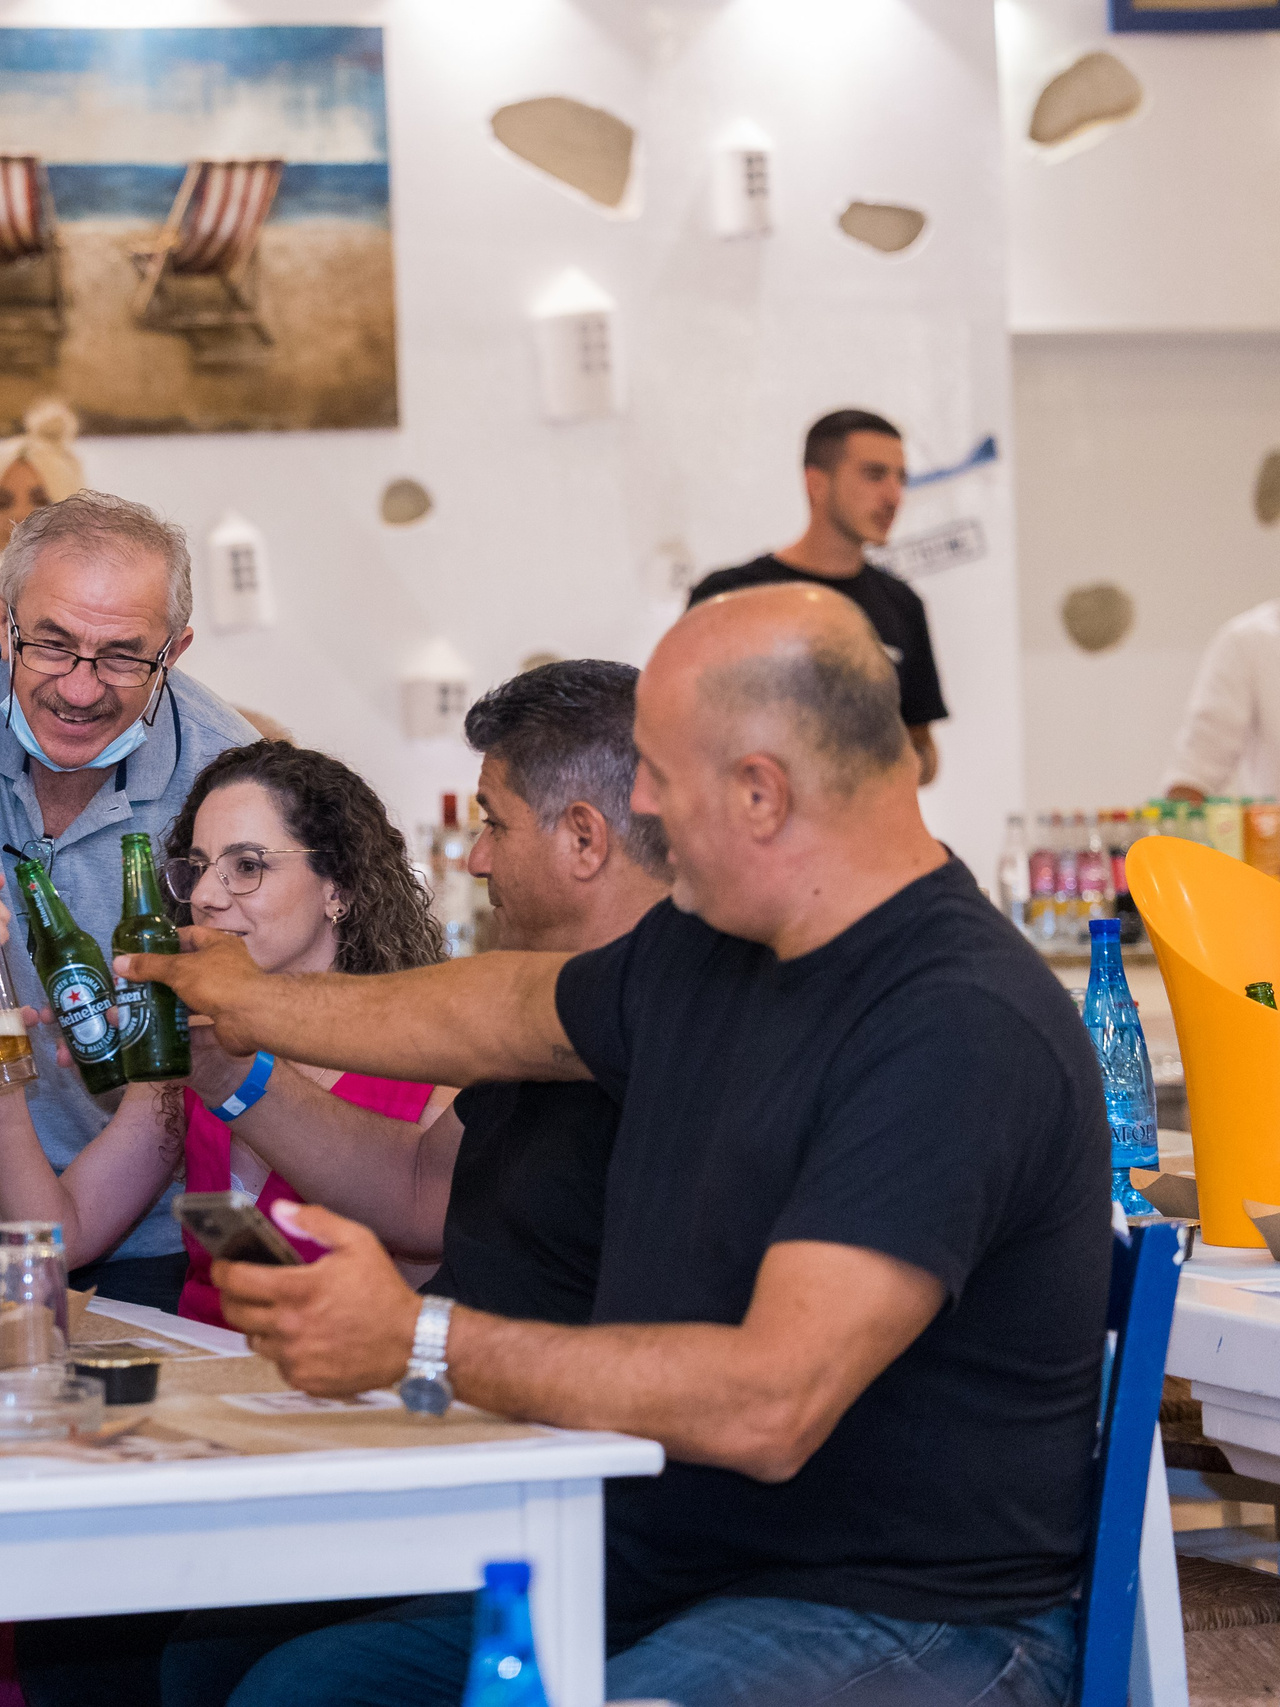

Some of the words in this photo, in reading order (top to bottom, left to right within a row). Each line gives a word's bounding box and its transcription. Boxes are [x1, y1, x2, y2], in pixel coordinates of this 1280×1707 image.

[32, 890, 51, 928] Heineken
[57, 998, 113, 1028] Heineken
[87, 1041, 104, 1053] MALT
